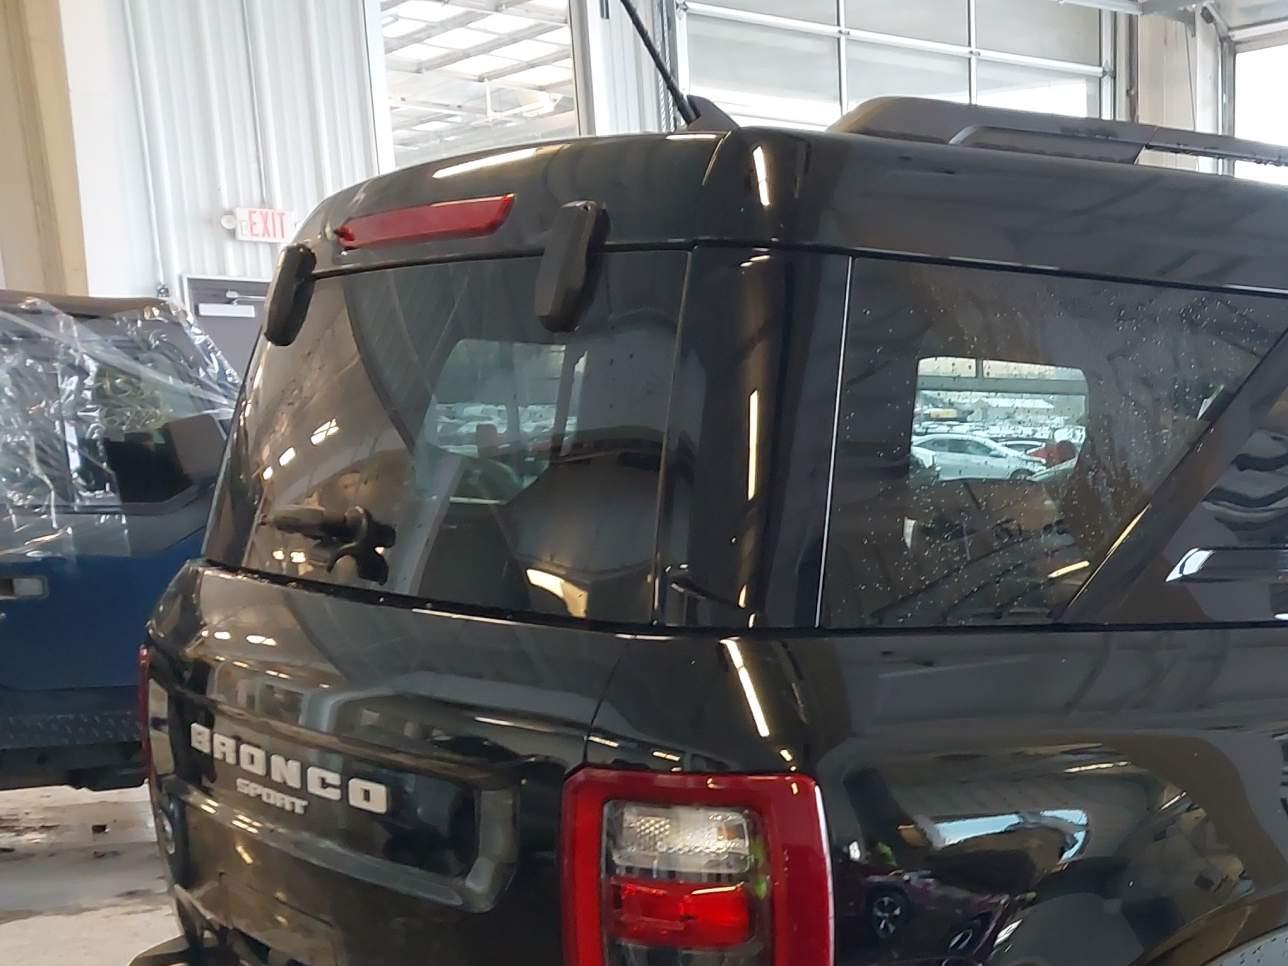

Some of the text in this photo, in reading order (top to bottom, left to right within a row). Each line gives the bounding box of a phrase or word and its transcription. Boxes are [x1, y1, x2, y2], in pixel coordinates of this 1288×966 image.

[248, 210, 286, 239] EXIT
[190, 722, 388, 815] BRONCO
[236, 778, 308, 815] SPORT
